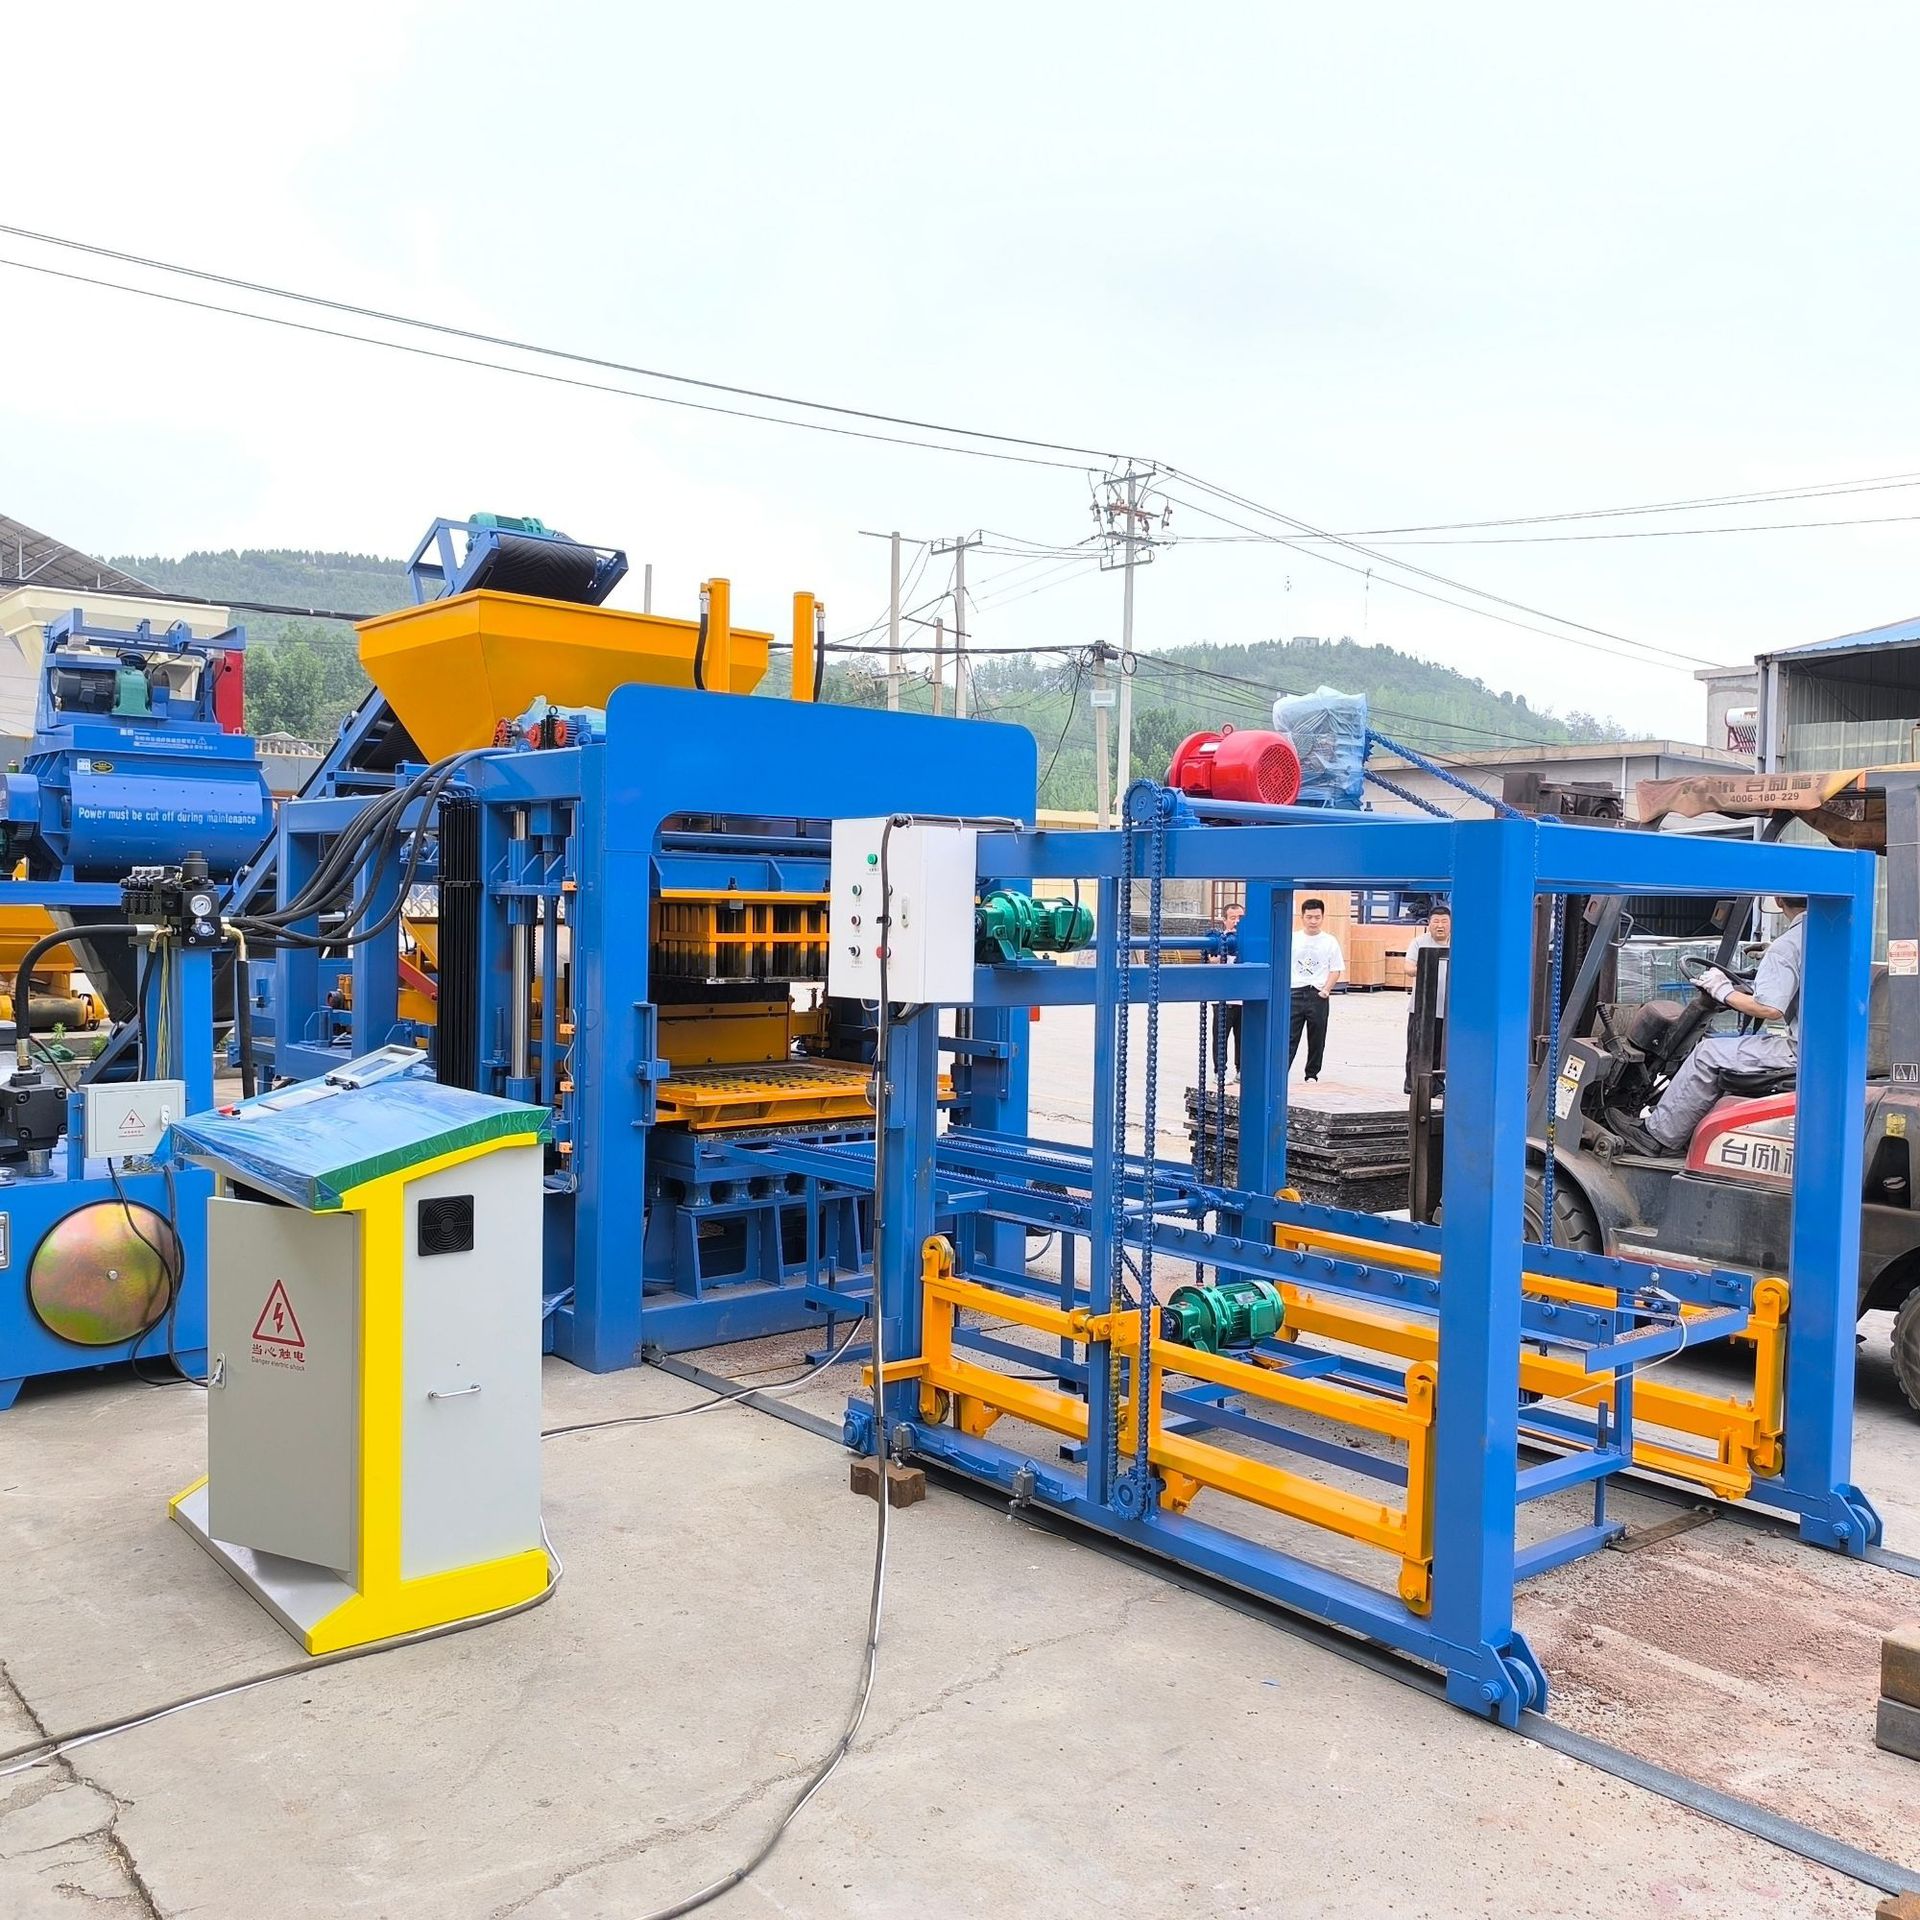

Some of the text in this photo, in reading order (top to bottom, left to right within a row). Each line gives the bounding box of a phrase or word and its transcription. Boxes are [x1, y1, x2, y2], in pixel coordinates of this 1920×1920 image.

[78, 807, 257, 825] Power must be cut off during maintenance
[251, 1344, 305, 1362] 当心触电
[251, 1356, 270, 1365] Danger
